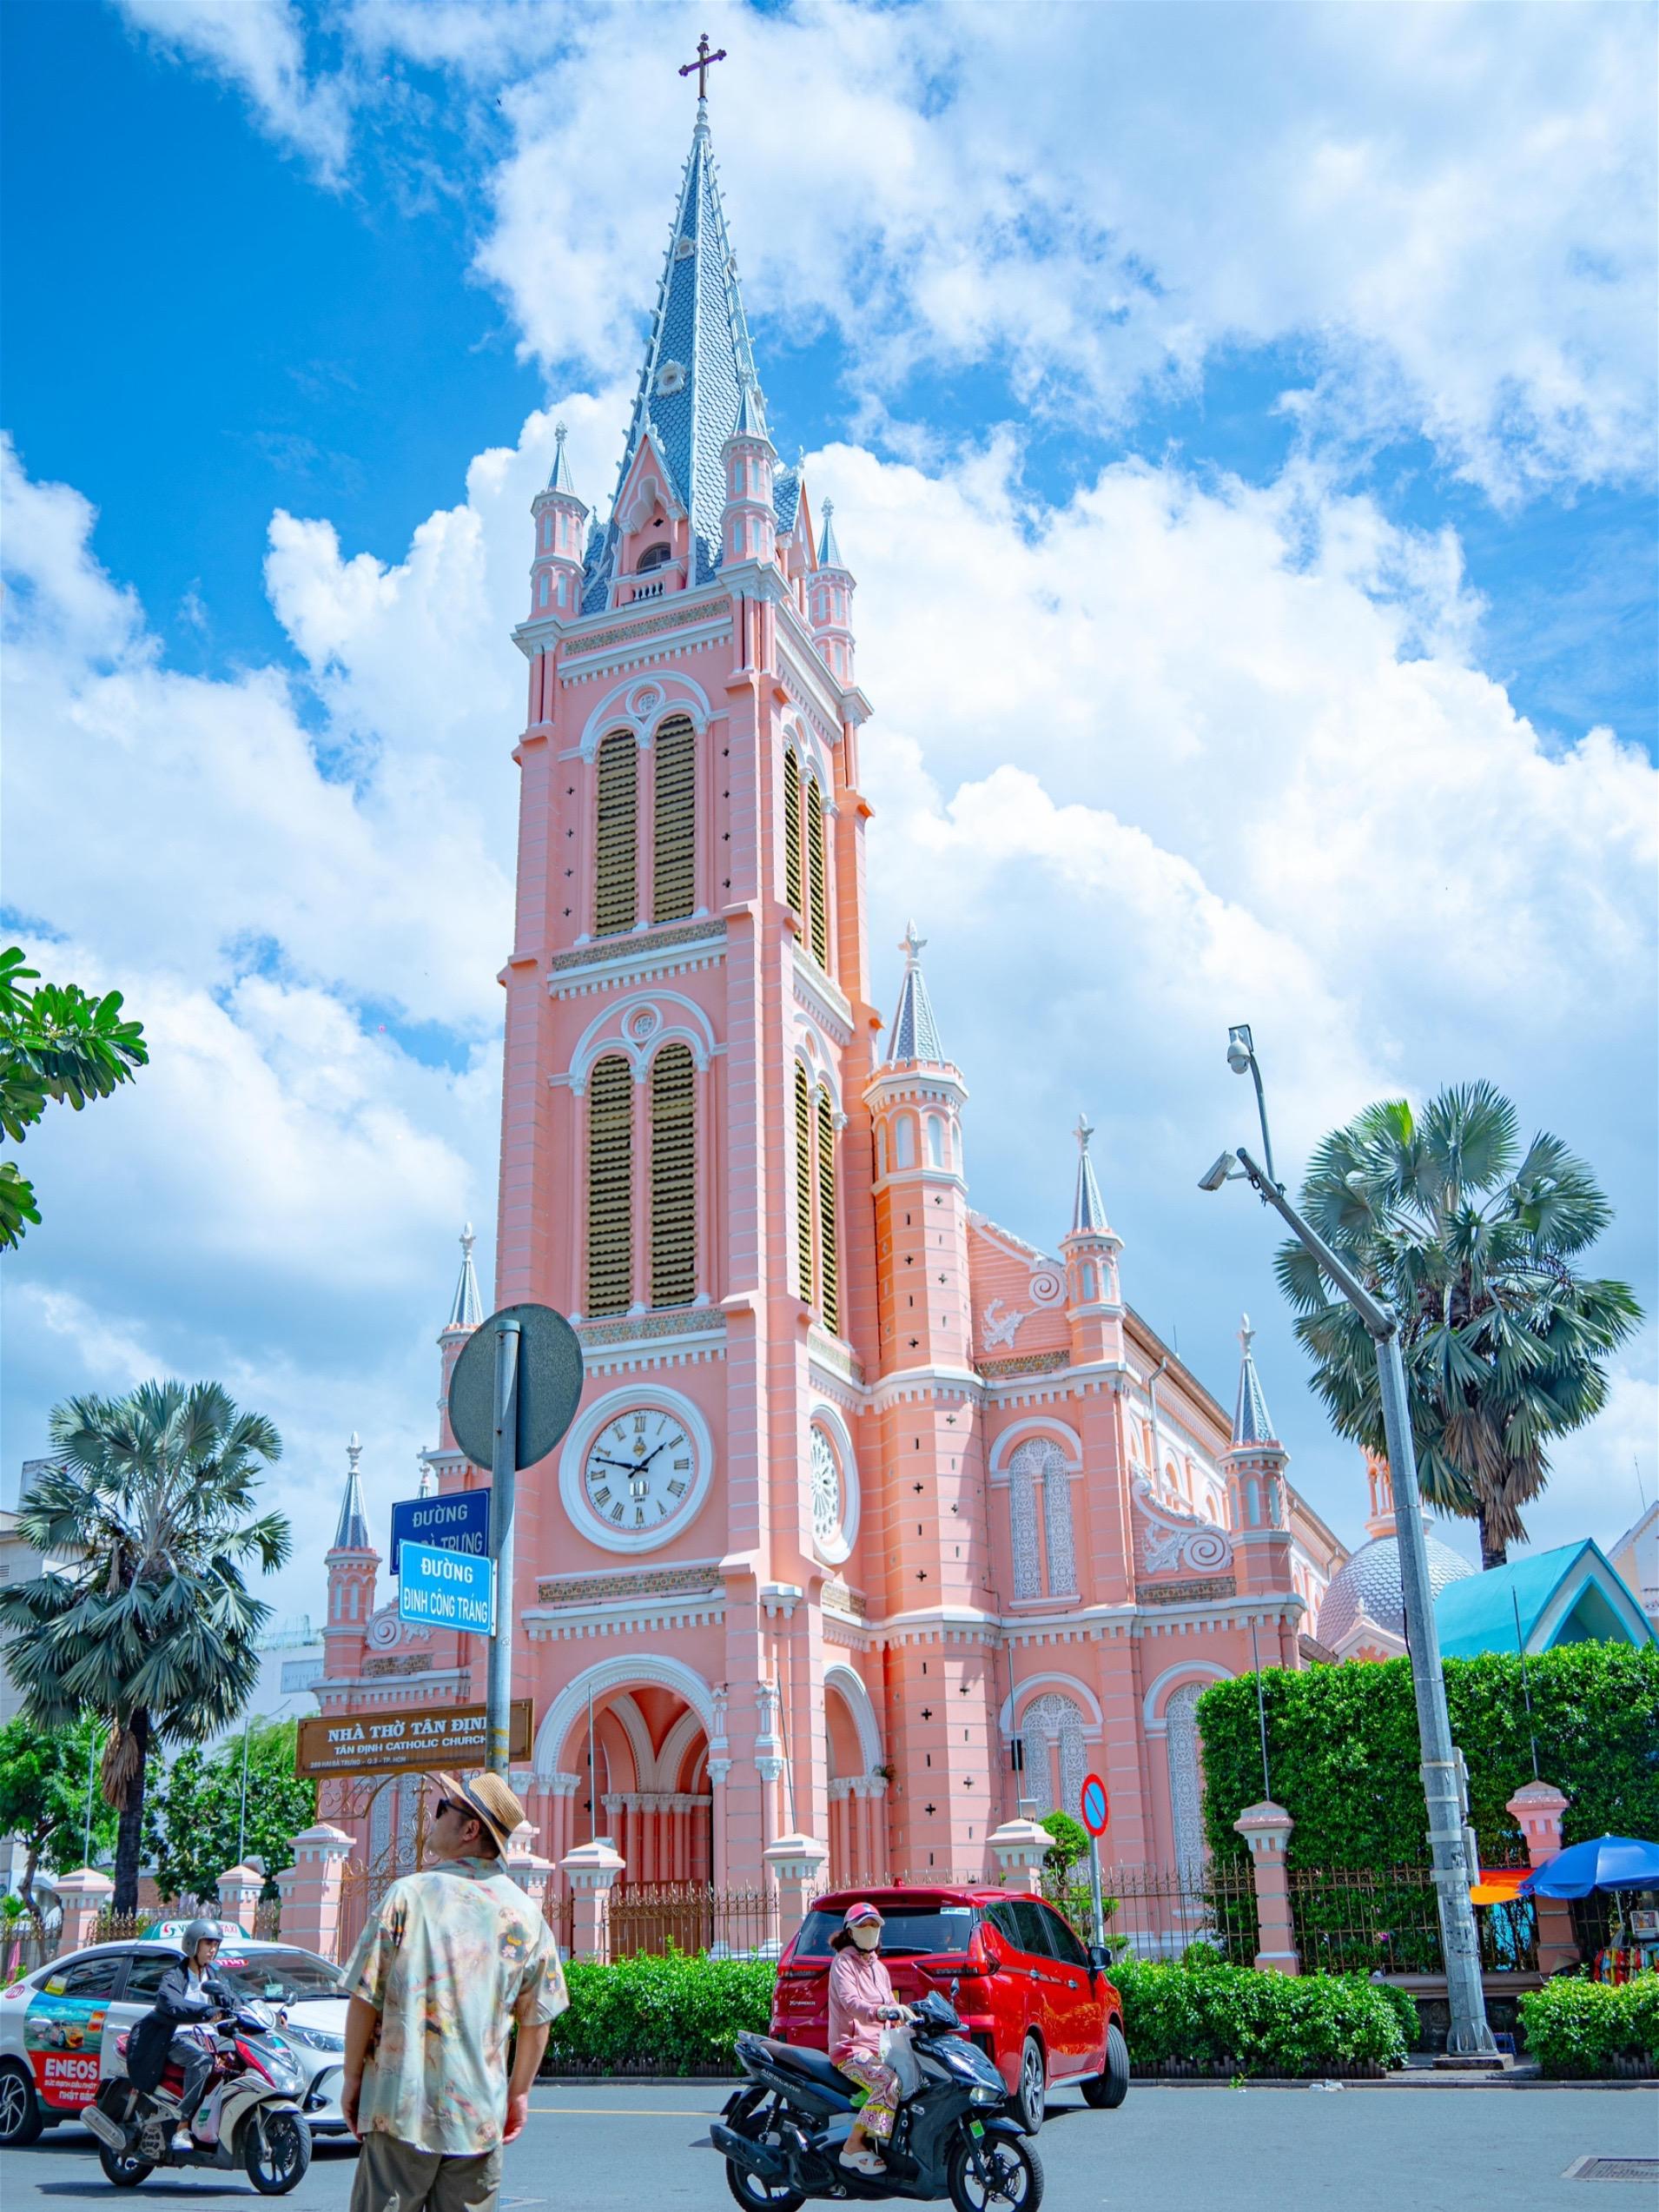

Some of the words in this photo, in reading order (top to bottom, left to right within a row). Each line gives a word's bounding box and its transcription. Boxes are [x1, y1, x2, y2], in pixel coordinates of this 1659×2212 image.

[412, 1504, 468, 1528] ĐƯỜNG
[421, 1557, 473, 1584] ĐƯỜNG
[403, 1587, 428, 1613] ĐINH
[430, 1587, 455, 1618] CÔNG
[457, 1593, 488, 1624] TRÁNG
[327, 1723, 366, 1743] NHÀ
[369, 1719, 406, 1738] THỜ
[411, 1719, 447, 1736] TÂN
[451, 1716, 486, 1734] ĐỊN
[334, 1744, 354, 1755] TÂN
[357, 1743, 383, 1755] ĐỊNH
[386, 1738, 439, 1752] CATHOLIC
[441, 1735, 486, 1747] CHURCH
[45, 2058, 97, 2080] ENEOS
